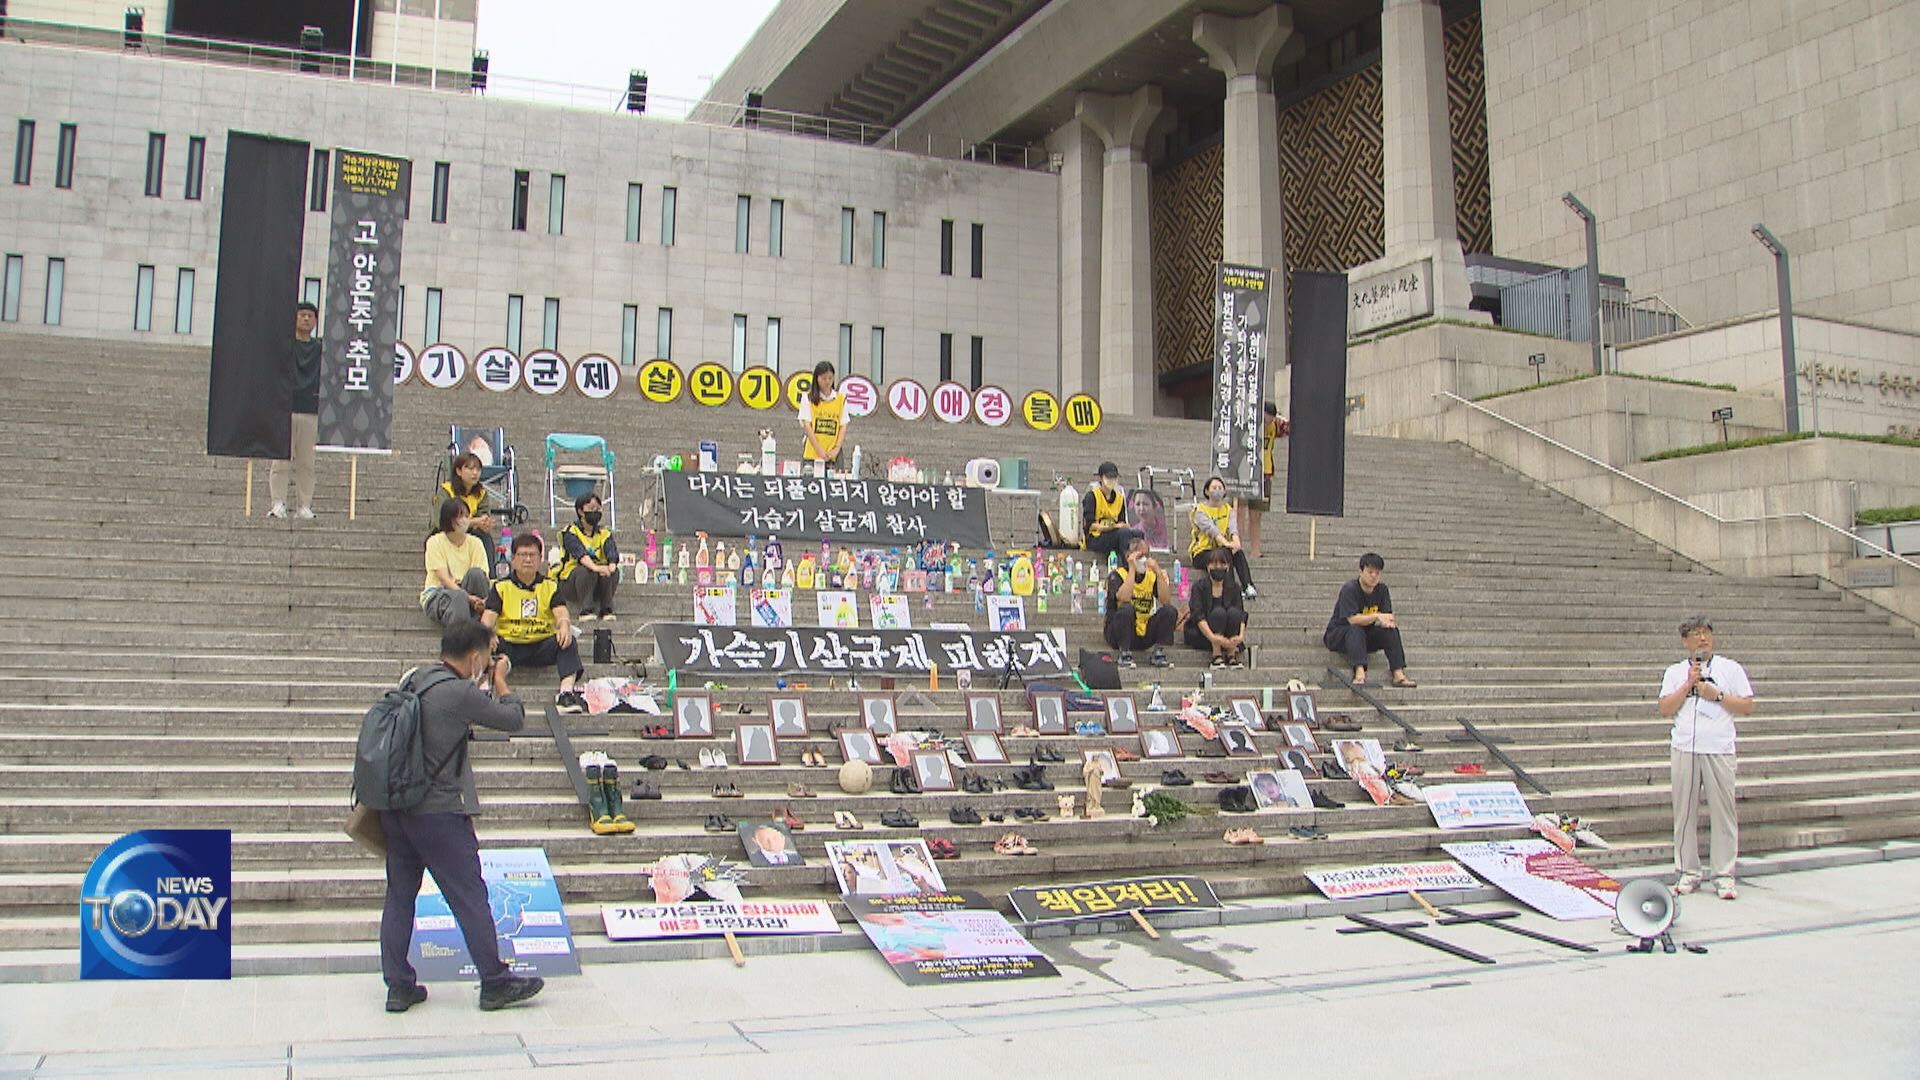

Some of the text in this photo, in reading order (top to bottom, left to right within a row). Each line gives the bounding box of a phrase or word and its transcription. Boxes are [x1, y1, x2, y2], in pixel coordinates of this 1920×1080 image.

[353, 221, 379, 244] 고
[348, 253, 377, 332] 안은주
[344, 339, 371, 391] 추모
[688, 473, 755, 498] 다시는
[878, 483, 940, 510] 않아야
[946, 486, 966, 510] 할
[741, 507, 927, 538] 가습기 살균제 참사
[615, 904, 737, 920] 가습기살균제
[1036, 879, 1199, 914] 책임져라!
[659, 919, 700, 932] 애경
